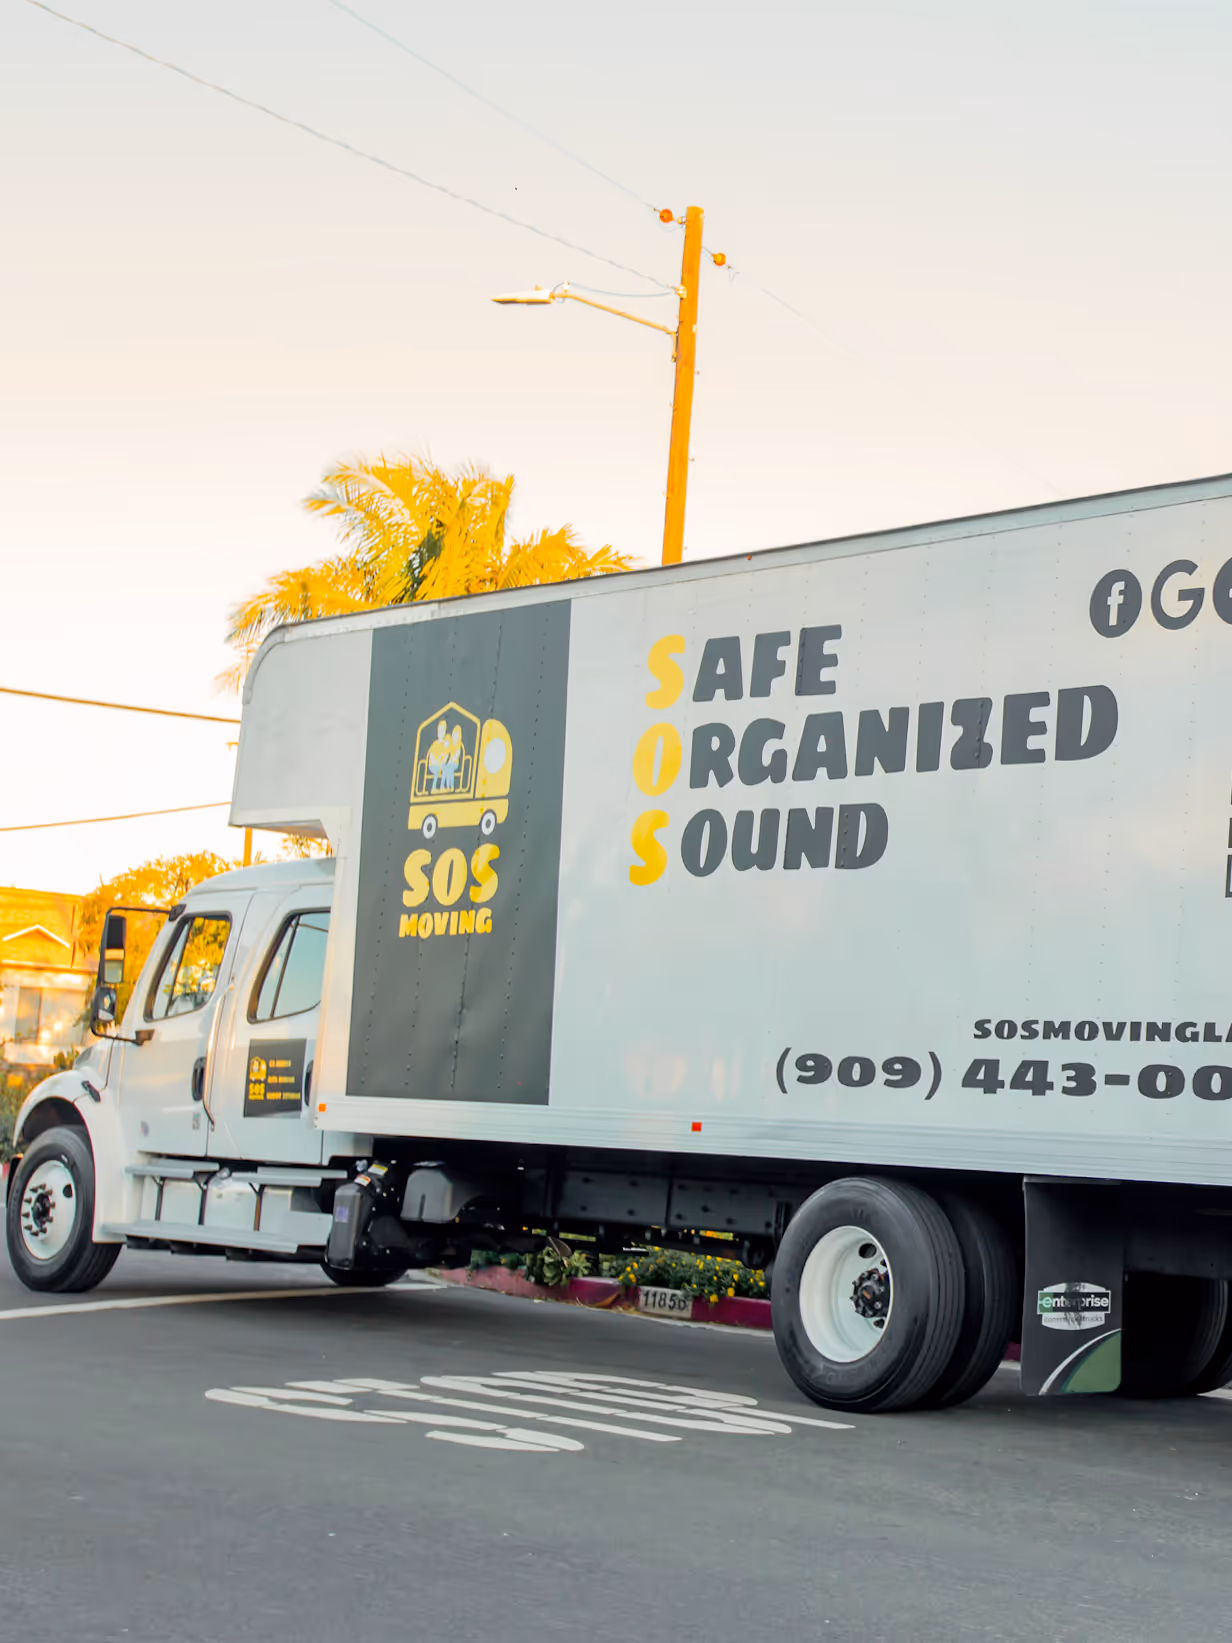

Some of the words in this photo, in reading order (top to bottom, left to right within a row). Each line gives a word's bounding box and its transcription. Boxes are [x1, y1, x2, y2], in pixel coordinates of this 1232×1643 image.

[645, 624, 843, 710] SAFE
[632, 684, 1119, 797] ORGANIZED
[402, 843, 501, 908] SOS
[628, 802, 889, 887] SOUND
[397, 907, 493, 940] MOVING
[775, 1047, 943, 1101] (909)
[204, 1370, 856, 1452] STOP
